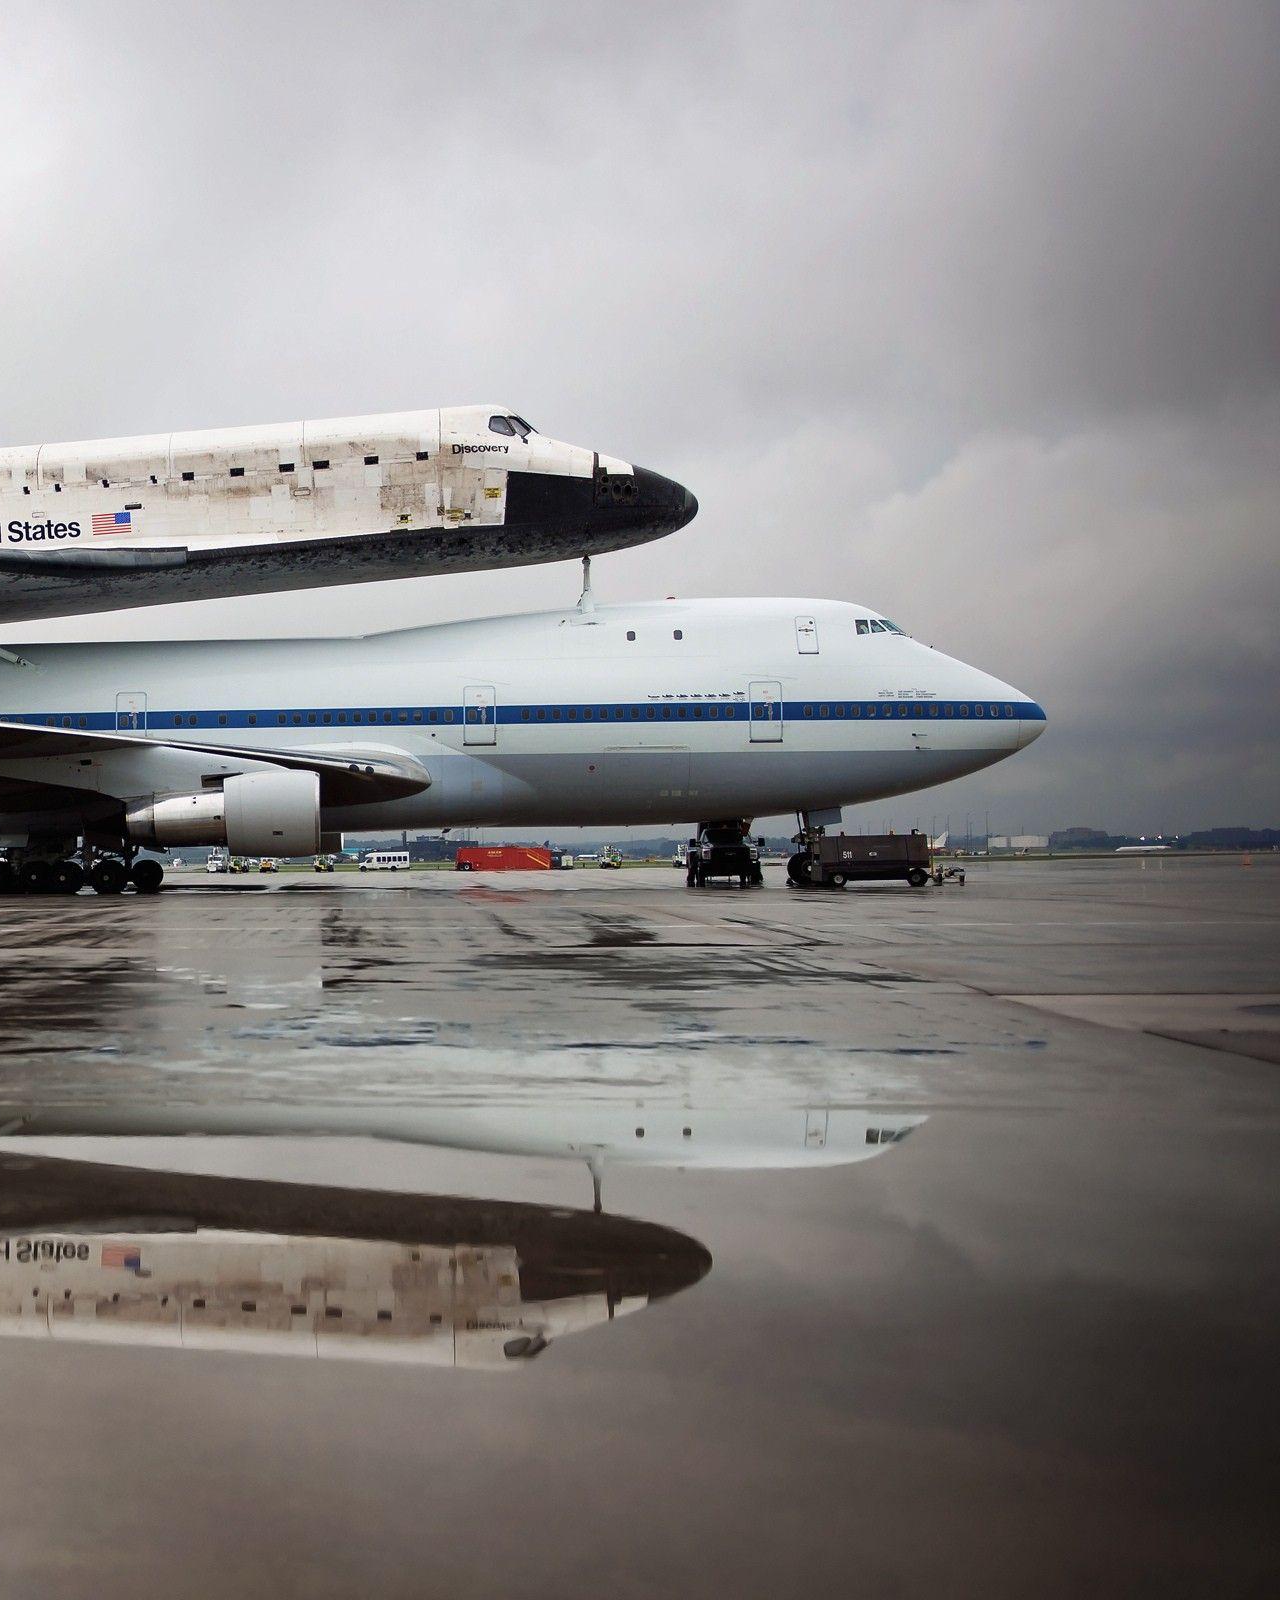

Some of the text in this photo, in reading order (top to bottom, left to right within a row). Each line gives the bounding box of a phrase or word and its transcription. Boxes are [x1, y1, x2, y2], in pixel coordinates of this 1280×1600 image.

[451, 443, 509, 455] Discovery
[7, 519, 82, 543] States
[842, 850, 853, 859] 511
